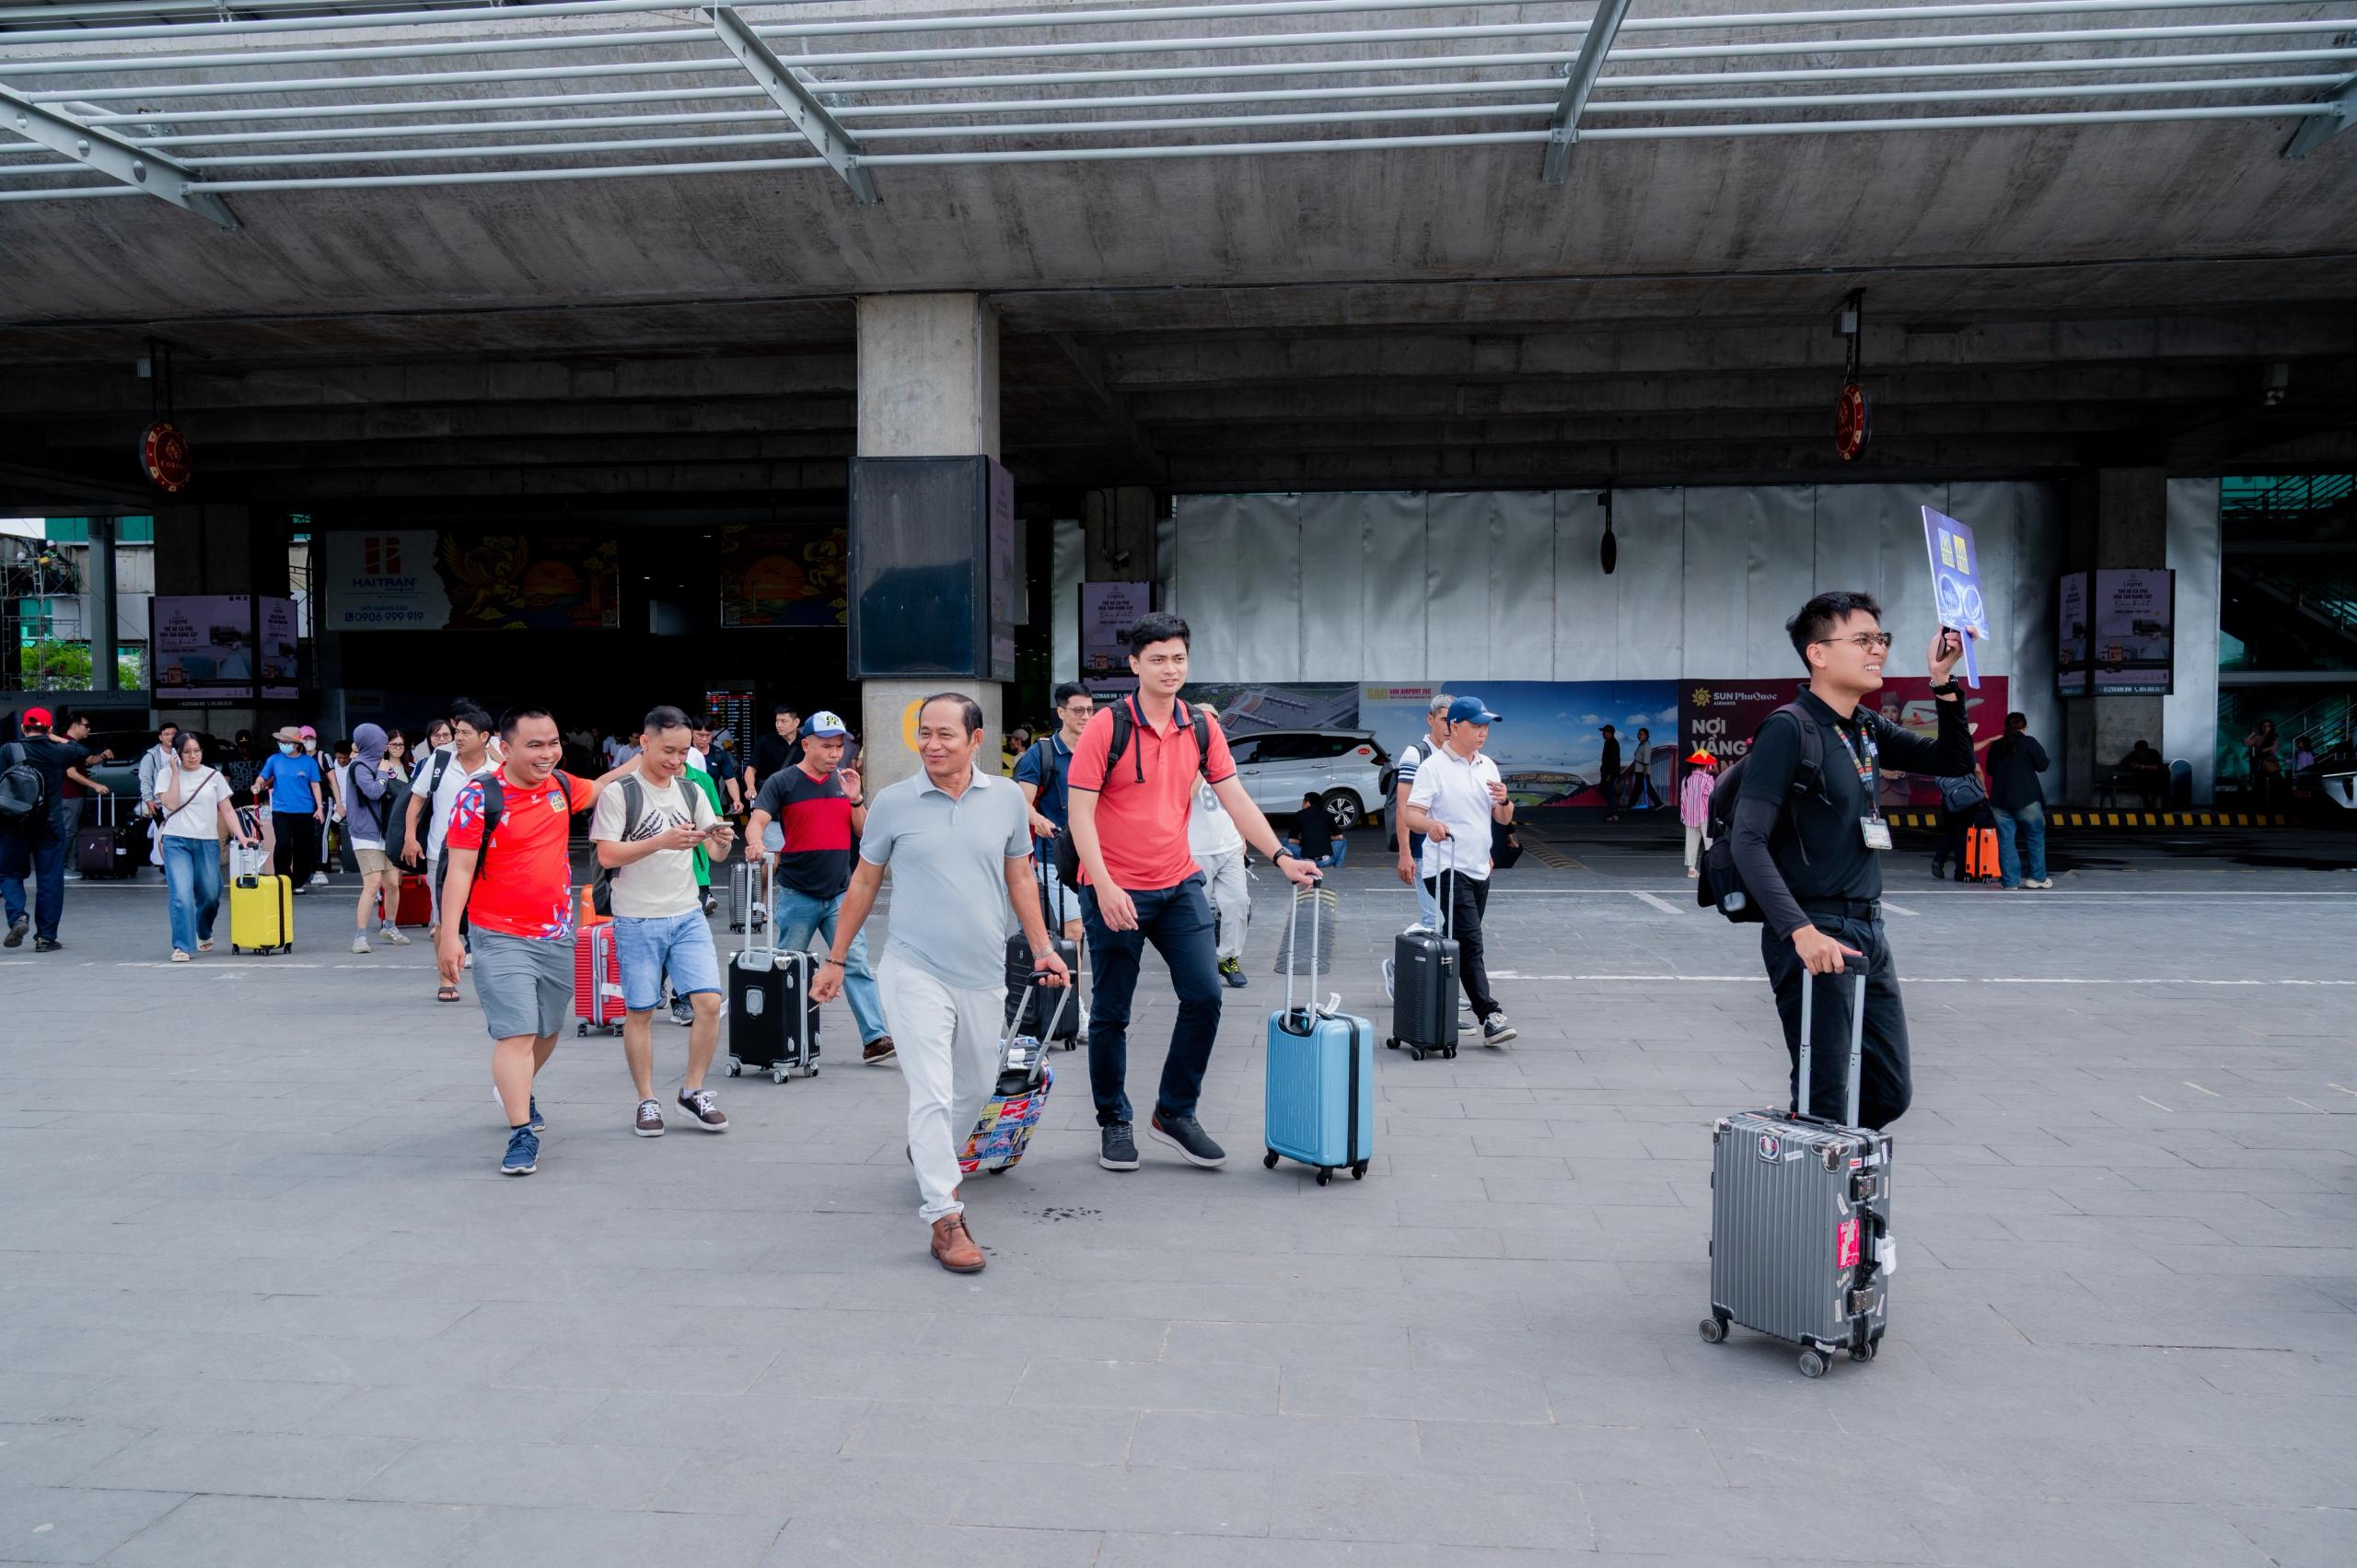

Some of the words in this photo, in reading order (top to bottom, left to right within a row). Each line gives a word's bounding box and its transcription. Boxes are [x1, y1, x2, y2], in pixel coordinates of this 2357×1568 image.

[354, 612, 382, 621] 0906
[385, 612, 404, 621] 999
[407, 612, 424, 621] 919
[1713, 692, 1734, 701] SUN
[1735, 692, 1778, 702] PhuQuoc
[1691, 717, 1726, 735] NƠI
